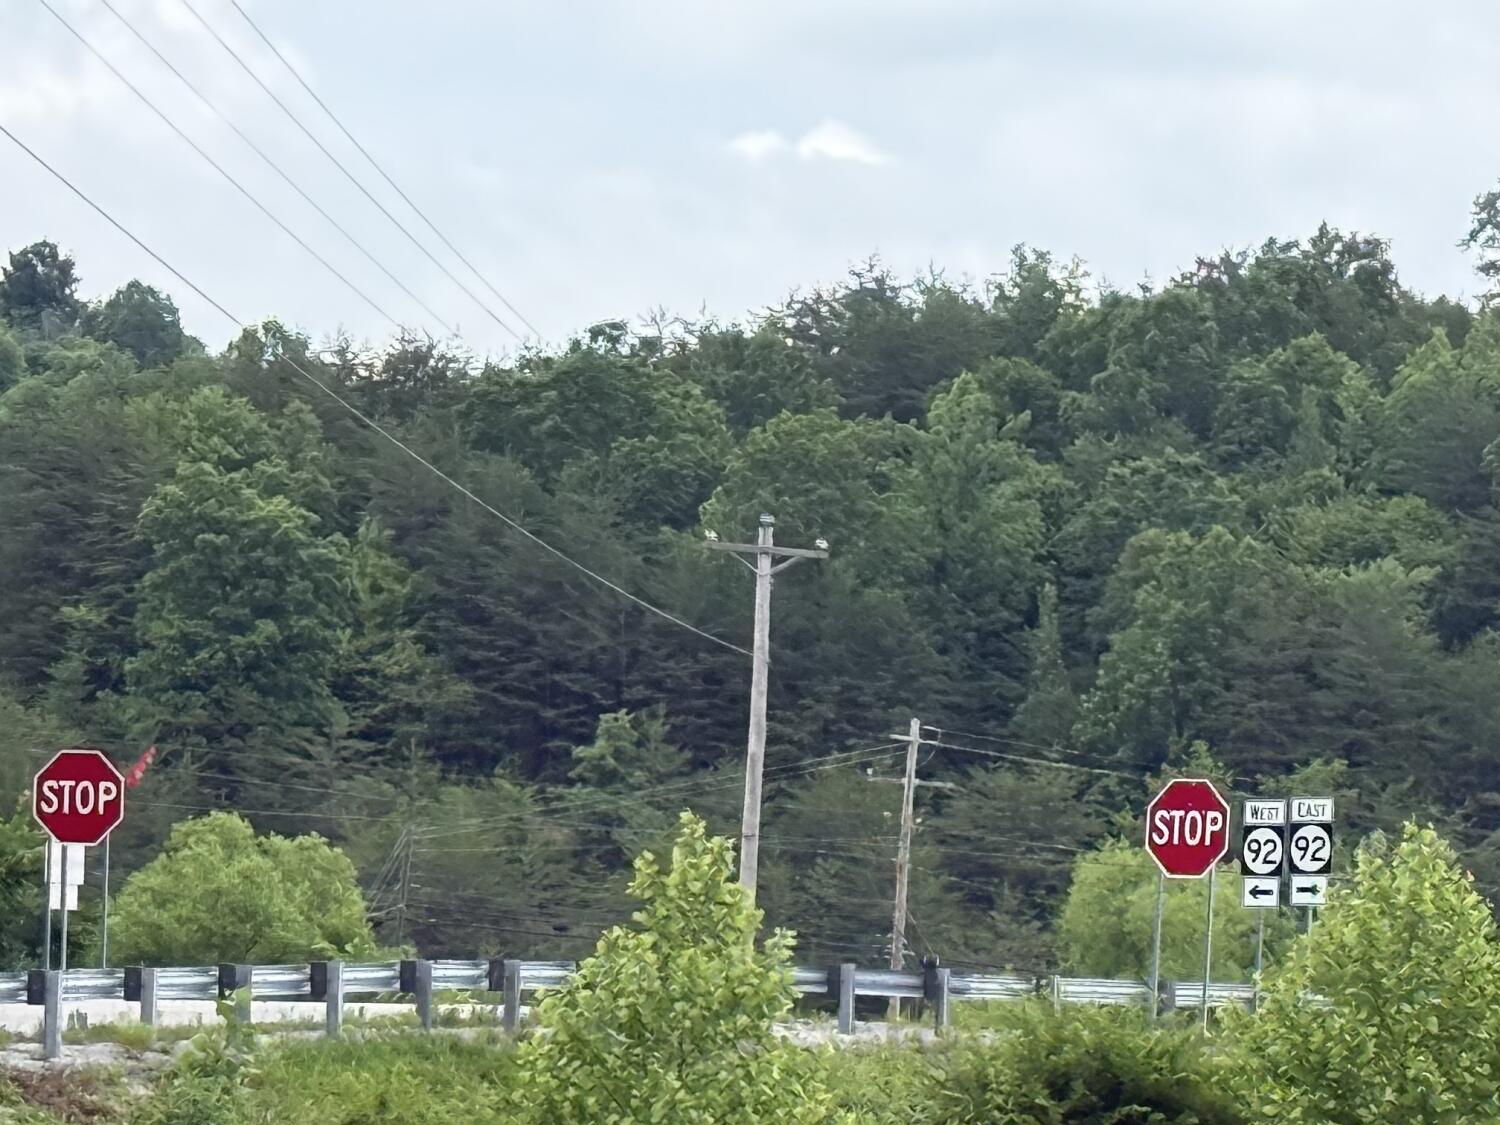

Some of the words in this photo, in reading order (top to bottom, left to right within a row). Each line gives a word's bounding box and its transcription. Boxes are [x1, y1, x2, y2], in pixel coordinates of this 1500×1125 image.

[41, 780, 117, 815] STOP
[1250, 804, 1280, 820] WEST
[1152, 809, 1223, 847] STOP
[1247, 838, 1278, 864] 92
[1294, 835, 1326, 861] 92
